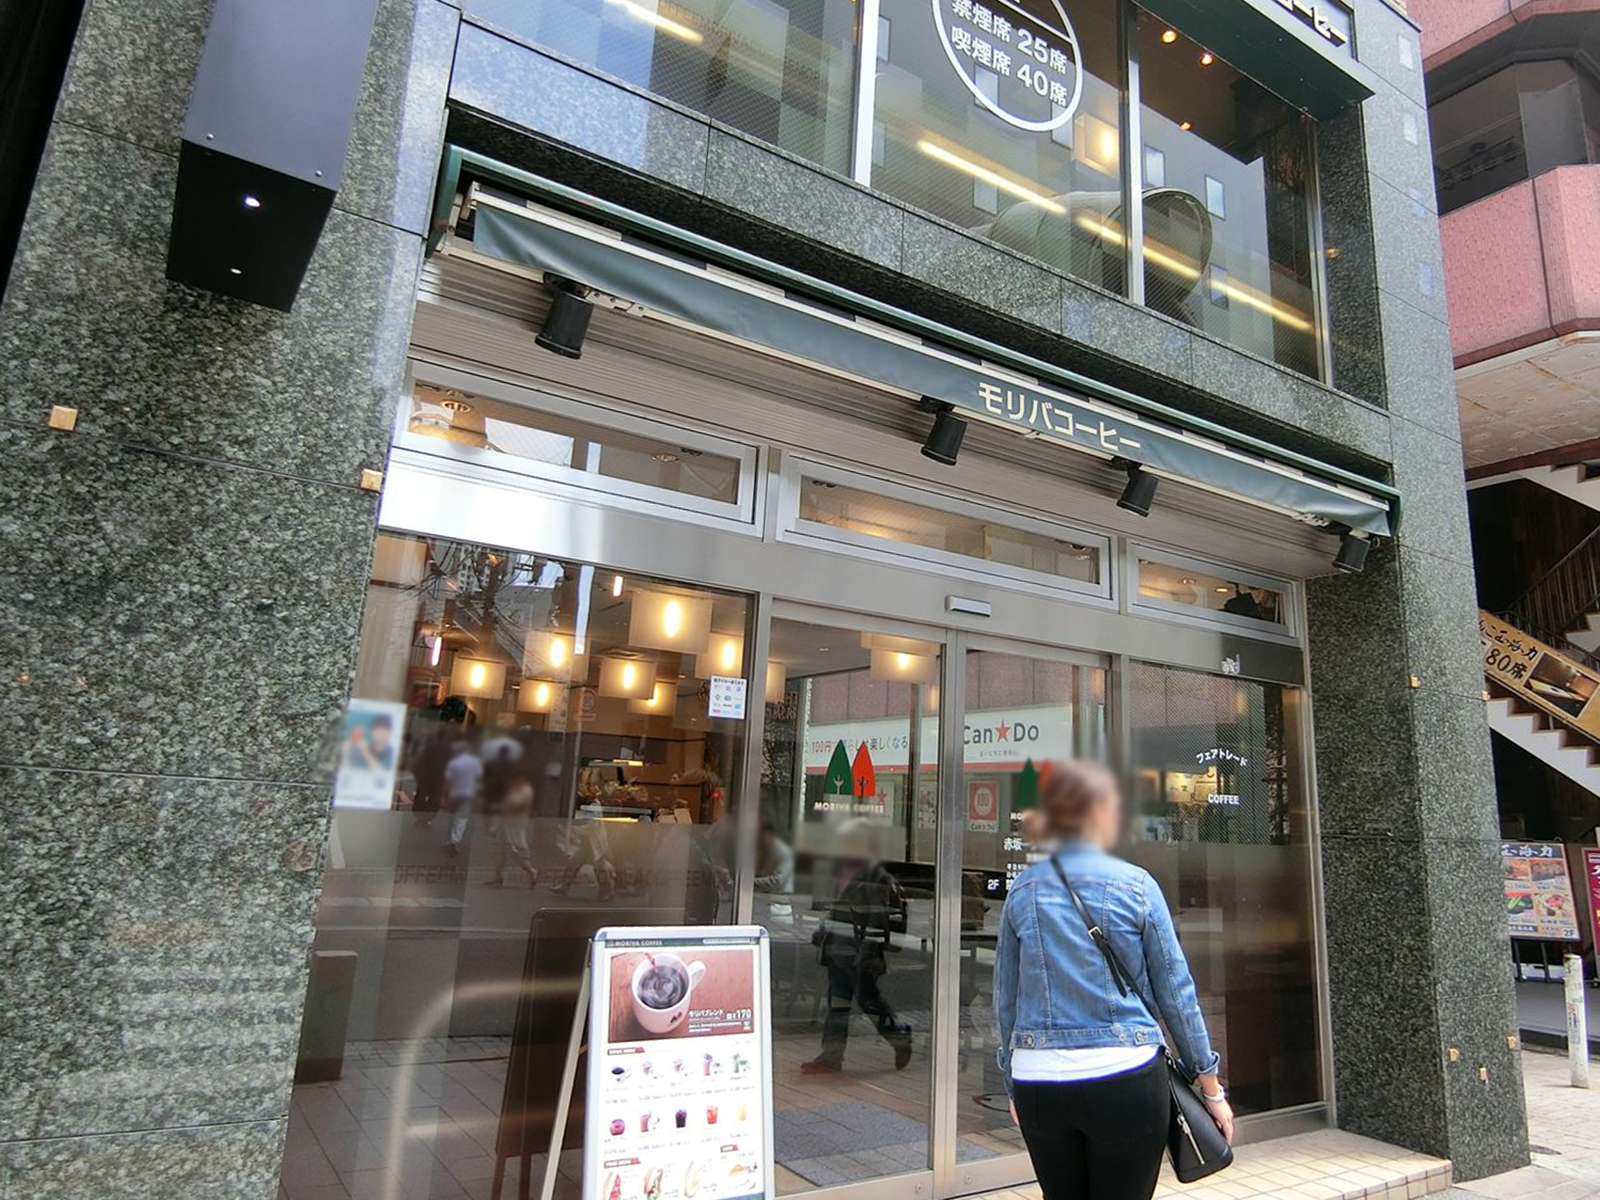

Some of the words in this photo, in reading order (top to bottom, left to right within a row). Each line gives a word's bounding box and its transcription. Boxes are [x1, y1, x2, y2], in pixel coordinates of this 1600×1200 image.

[952, 0, 1012, 42] 禁煙席
[1017, 29, 1067, 75] 25席
[951, 26, 1012, 77] 喫煙席
[1016, 63, 1067, 107] 40席
[978, 382, 1141, 451] モリバコーヒー
[1486, 648, 1528, 679] 80席
[1196, 748, 1248, 767] フェアトレード
[1208, 793, 1240, 805] COFFEE
[987, 879, 999, 890] 2F
